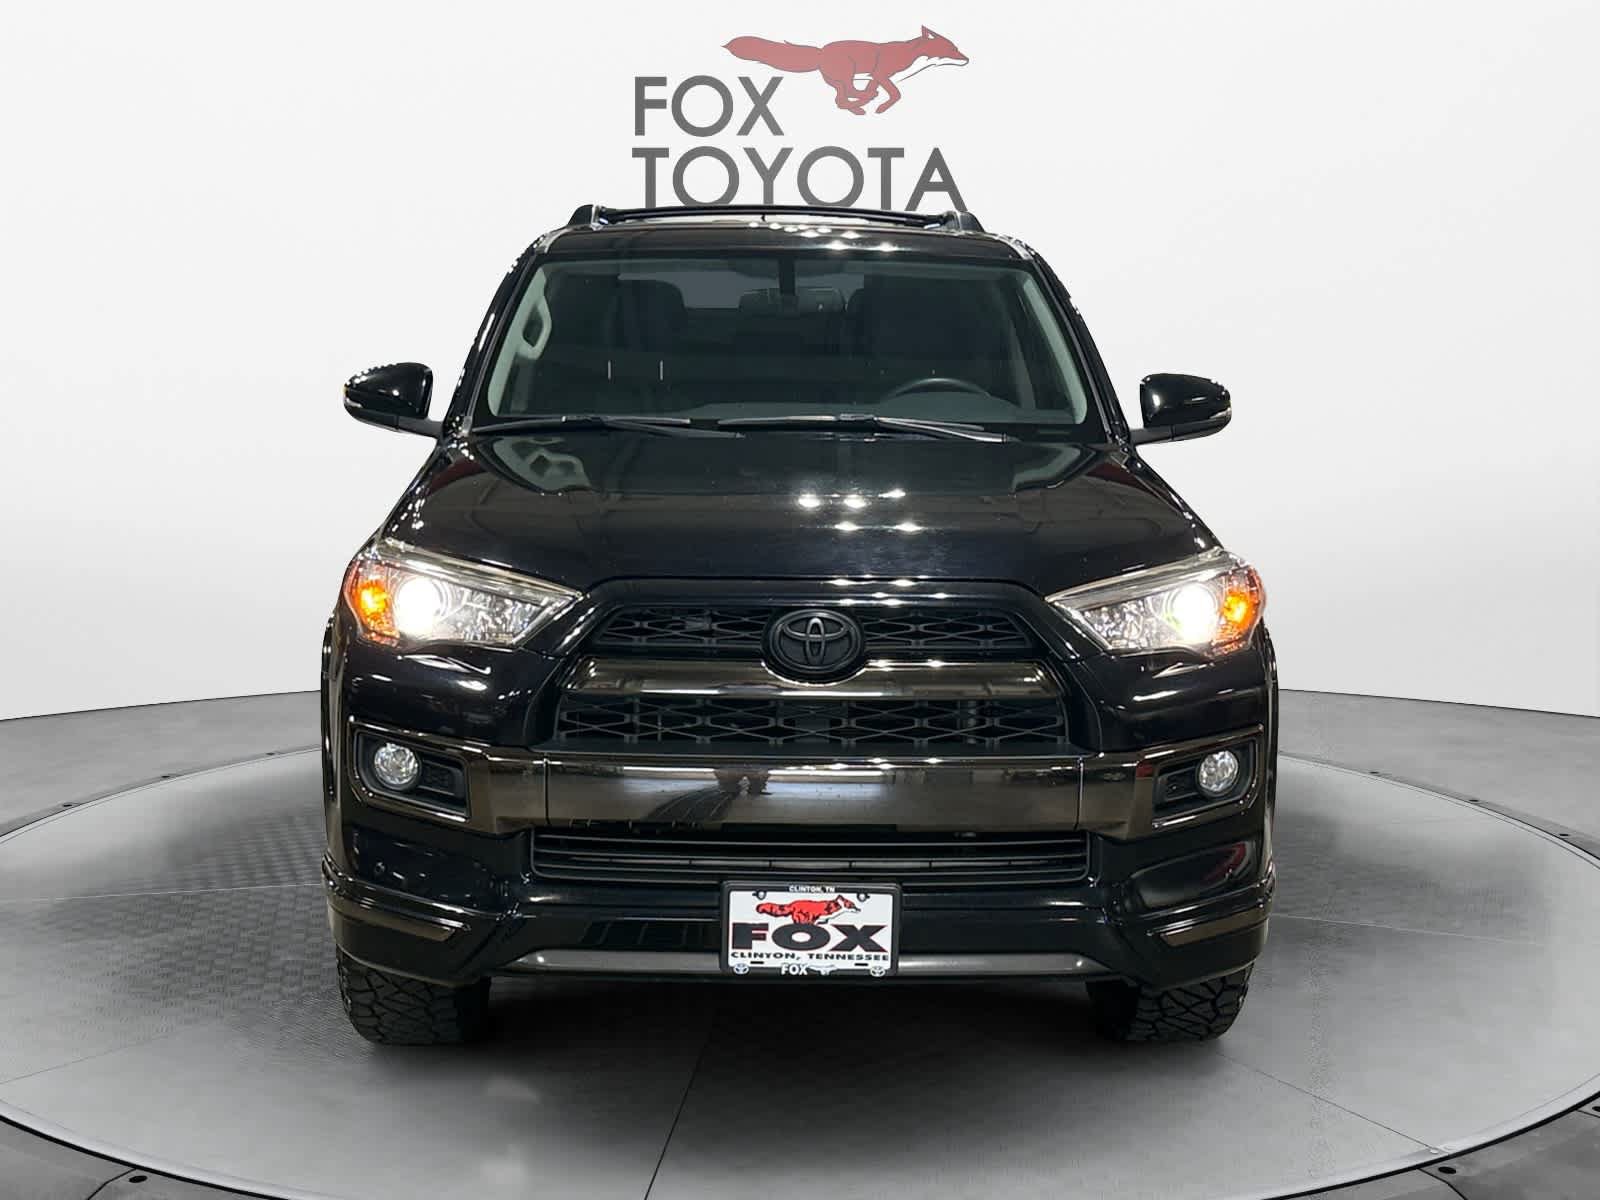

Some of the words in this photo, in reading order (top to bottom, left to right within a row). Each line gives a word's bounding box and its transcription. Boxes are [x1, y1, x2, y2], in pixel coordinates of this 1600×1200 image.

[634, 75, 784, 137] FOX
[631, 146, 968, 211] TOYOTA
[732, 922, 888, 952] FOX
[781, 964, 808, 976] FOX
[808, 953, 889, 962] TENNESSEE
